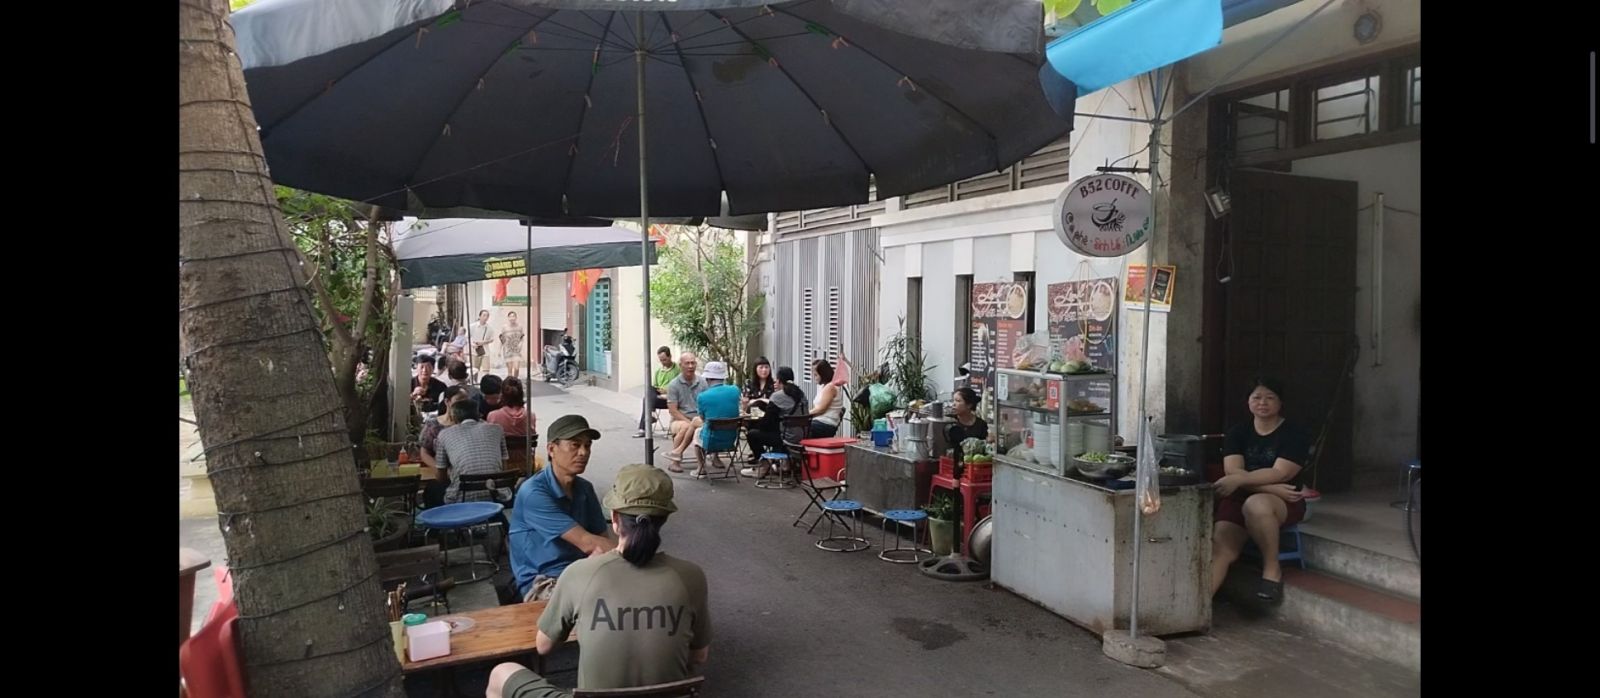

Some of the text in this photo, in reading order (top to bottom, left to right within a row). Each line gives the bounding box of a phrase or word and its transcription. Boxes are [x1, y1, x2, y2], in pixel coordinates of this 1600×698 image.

[1080, 178, 1140, 200] B52 COFFE
[590, 598, 685, 637] Army
